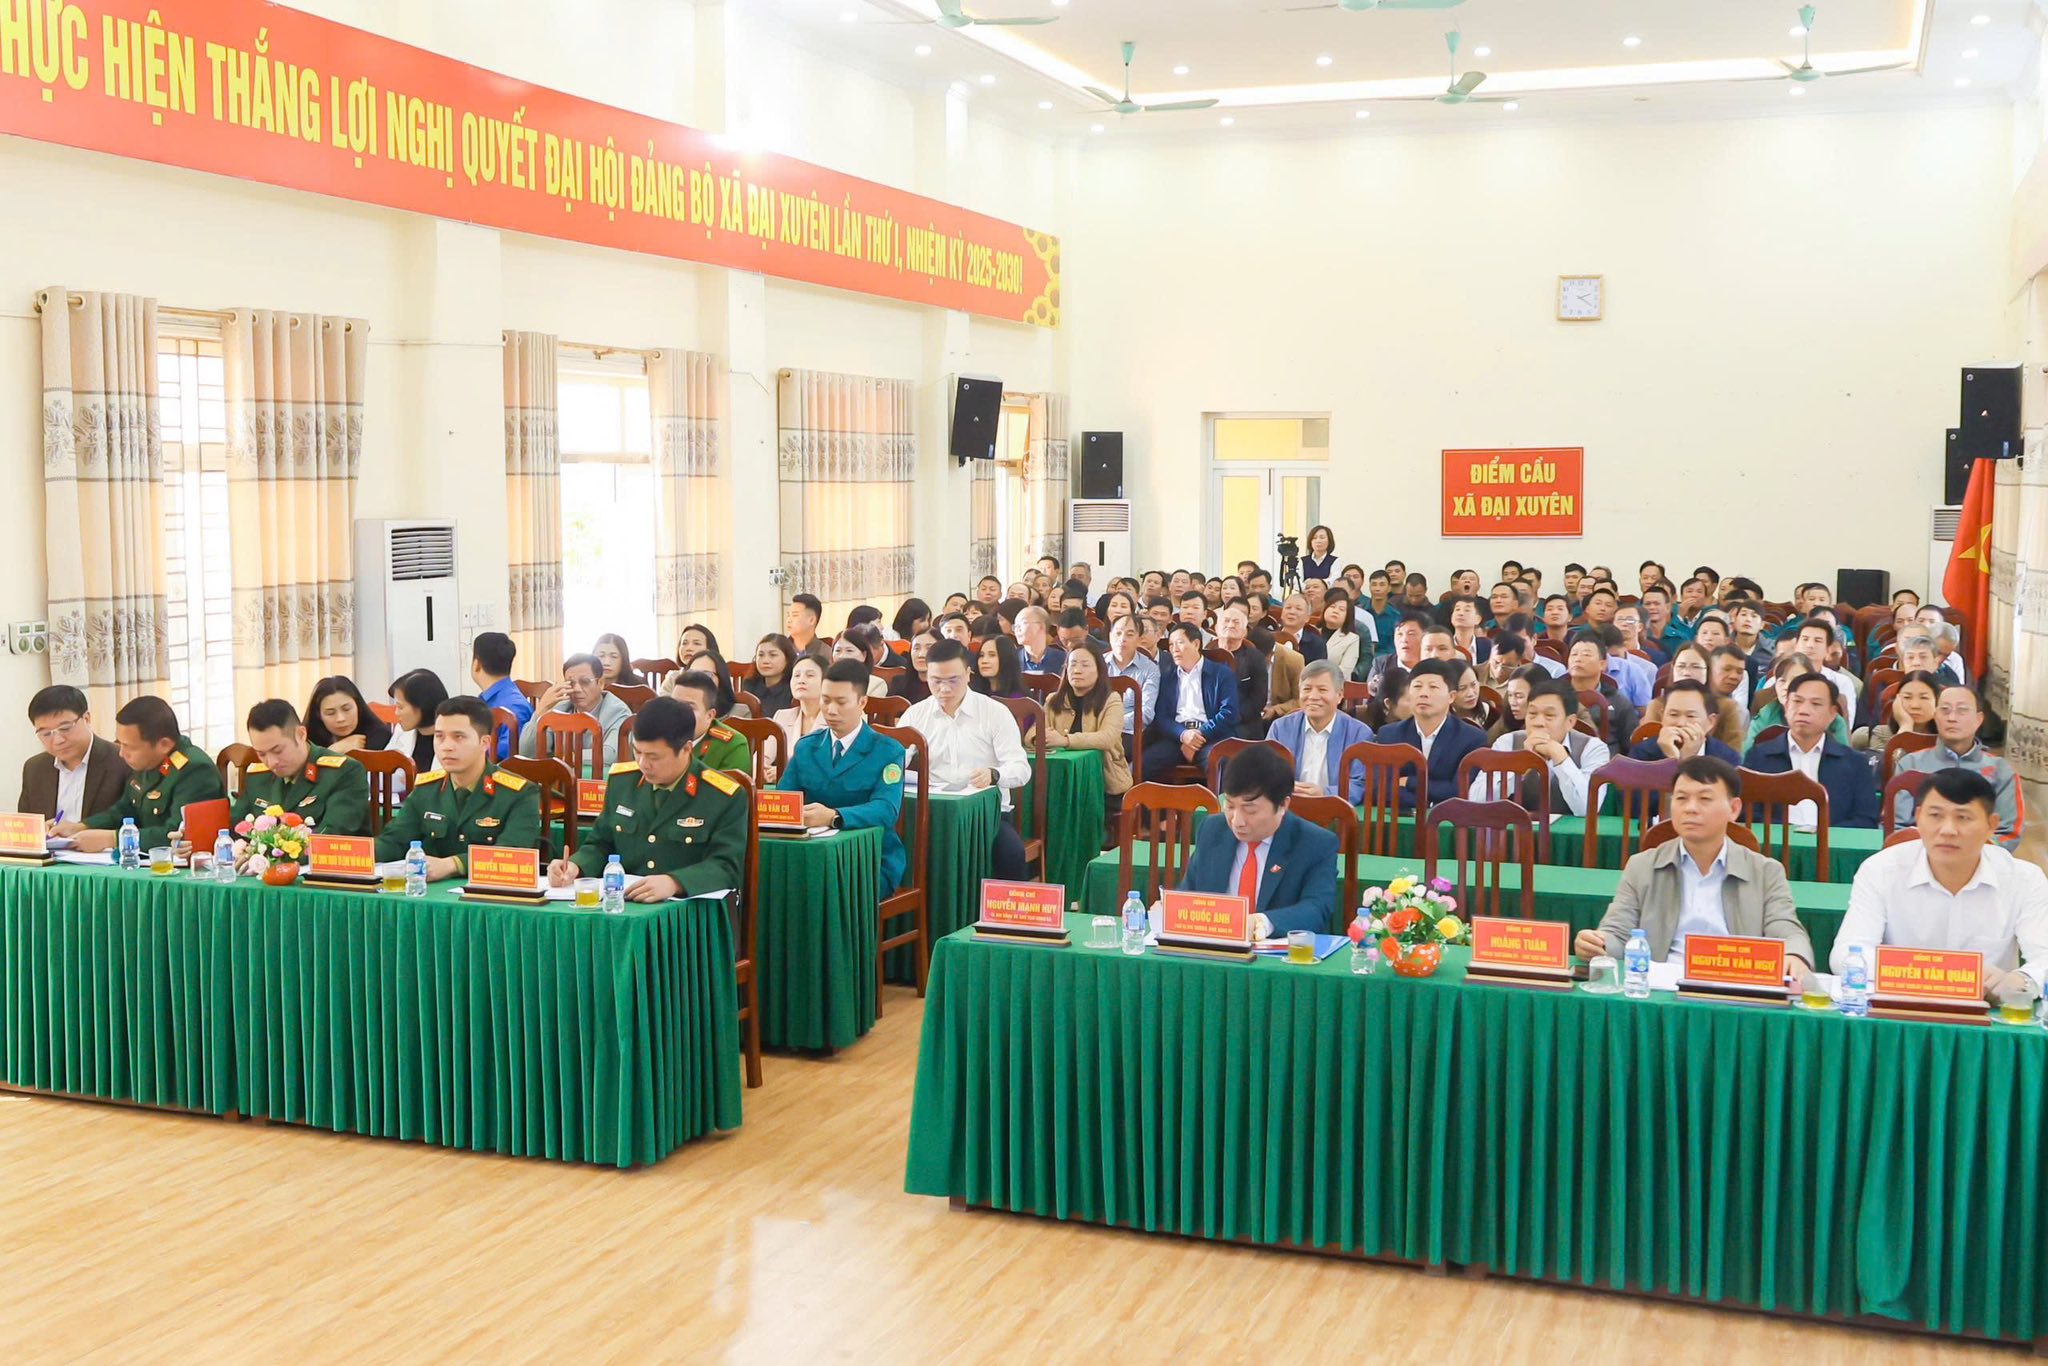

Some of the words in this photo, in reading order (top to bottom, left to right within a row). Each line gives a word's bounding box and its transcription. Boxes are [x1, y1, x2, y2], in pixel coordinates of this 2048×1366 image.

[0, 0, 89, 103] HỰC
[102, 9, 197, 126] HIỆN
[206, 27, 322, 144] THẮNG
[330, 75, 378, 169] LỢI
[386, 90, 454, 189] NGHỊ
[461, 106, 539, 192] QUYẾT
[544, 132, 583, 213] ĐẠI
[589, 135, 625, 222] HỘI
[630, 139, 685, 222] ĐẢNG
[690, 161, 715, 239] BỘ
[719, 169, 743, 234] XÃ
[747, 182, 776, 250] ĐẠI
[780, 190, 831, 253] XUYÊN
[833, 191, 862, 260] LẦN
[865, 210, 893, 266] THỨ
[894, 223, 903, 274] I,
[906, 222, 947, 285] NHIỆM
[967, 242, 1023, 295] 2025-2030!
[1470, 456, 1515, 484] ĐIỂM
[1520, 456, 1556, 484] CẦU
[1453, 493, 1476, 517] XÃ
[1481, 496, 1511, 521] ĐẠI
[1515, 492, 1574, 517] XUYÊN
[987, 898, 1017, 911] NGUYỄN
[1042, 904, 1058, 915] HUY
[1190, 909, 1211, 923] QUỐC
[1213, 912, 1231, 924] ANH
[1881, 963, 1921, 979] NGUYỄN
[1923, 966, 1945, 980] VĂN
